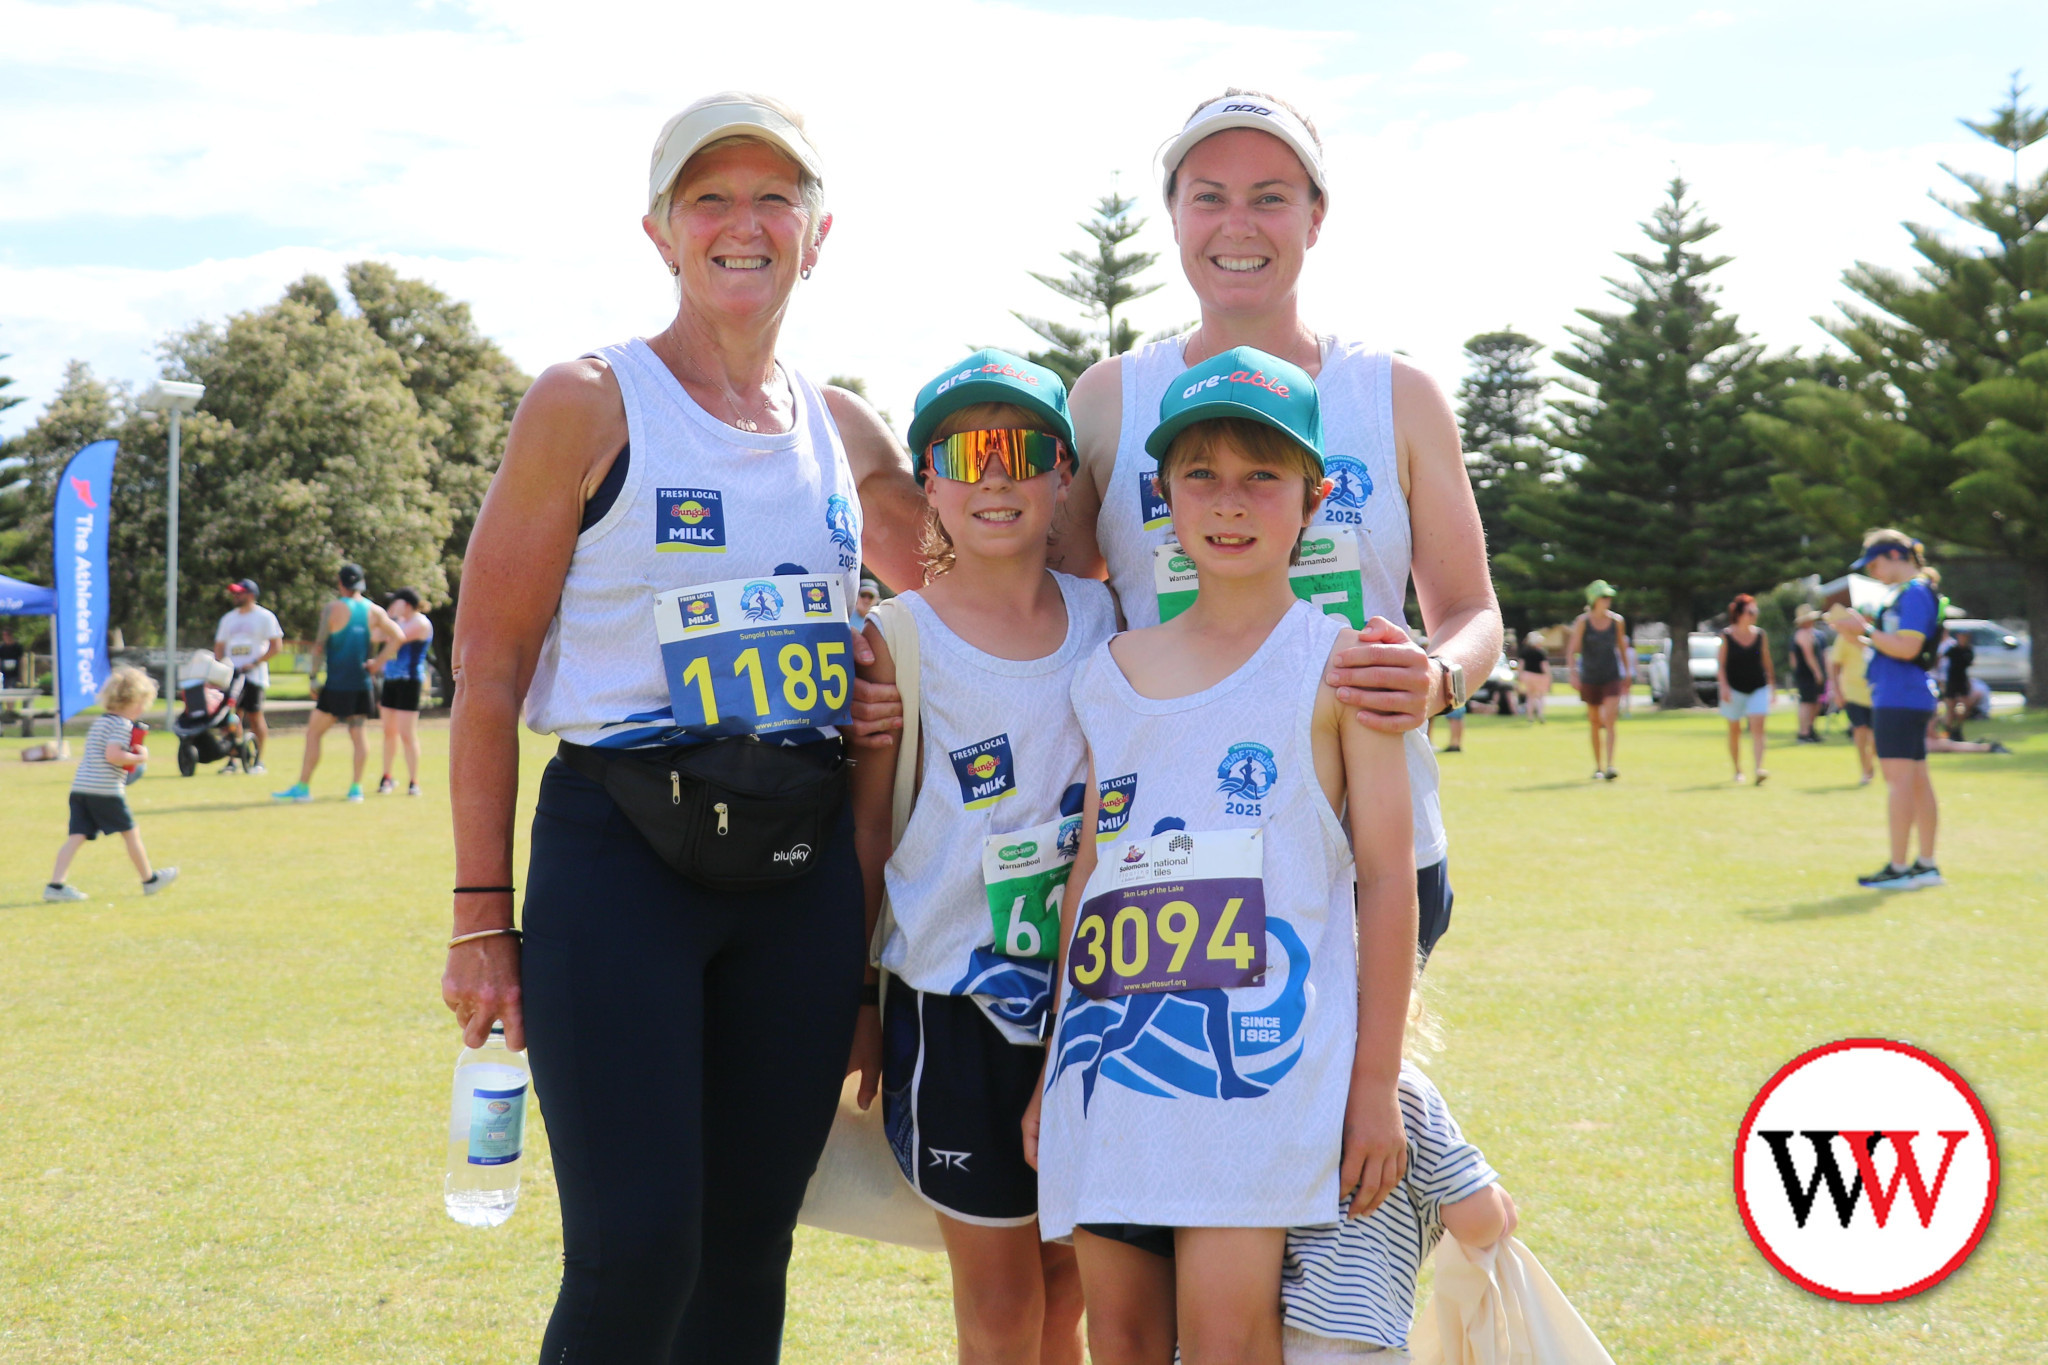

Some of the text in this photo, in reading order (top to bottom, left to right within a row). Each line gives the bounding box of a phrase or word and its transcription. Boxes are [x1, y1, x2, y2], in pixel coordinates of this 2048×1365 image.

[936, 363, 1040, 395] are-able
[1182, 370, 1290, 399] are-able
[661, 490, 719, 500] FRESH LOCAL
[671, 504, 711, 518] Sungold
[1325, 509, 1363, 525] 2025
[669, 527, 715, 541] MILK
[1300, 542, 1332, 552] pecsavers
[680, 592, 713, 602] FRESH LOCAL
[75, 513, 98, 696] The Athlete's Foot
[808, 602, 828, 611] MILK
[688, 613, 713, 626] MILK
[740, 628, 795, 640] Sungold 10km Run
[682, 641, 848, 726] 1185
[952, 736, 1006, 761] FRESH LOCAL
[1221, 750, 1245, 771] SURF
[1255, 752, 1277, 775] SURF
[972, 774, 1007, 799] MILK
[1111, 775, 1136, 788] LOCAL
[1225, 802, 1262, 817] 2025
[773, 848, 810, 863] blusky
[1153, 856, 1189, 867] national
[998, 857, 1041, 871] Warnambool
[1119, 862, 1150, 872] Solomons
[1154, 868, 1172, 877] tiles
[1123, 891, 1136, 899] 3km
[1137, 889, 1148, 897] Lap
[1074, 898, 1255, 985] 3094
[1123, 978, 1187, 991] www.surftosurf.org
[1240, 1016, 1280, 1028] SINCE
[1240, 1029, 1281, 1043] 1982
